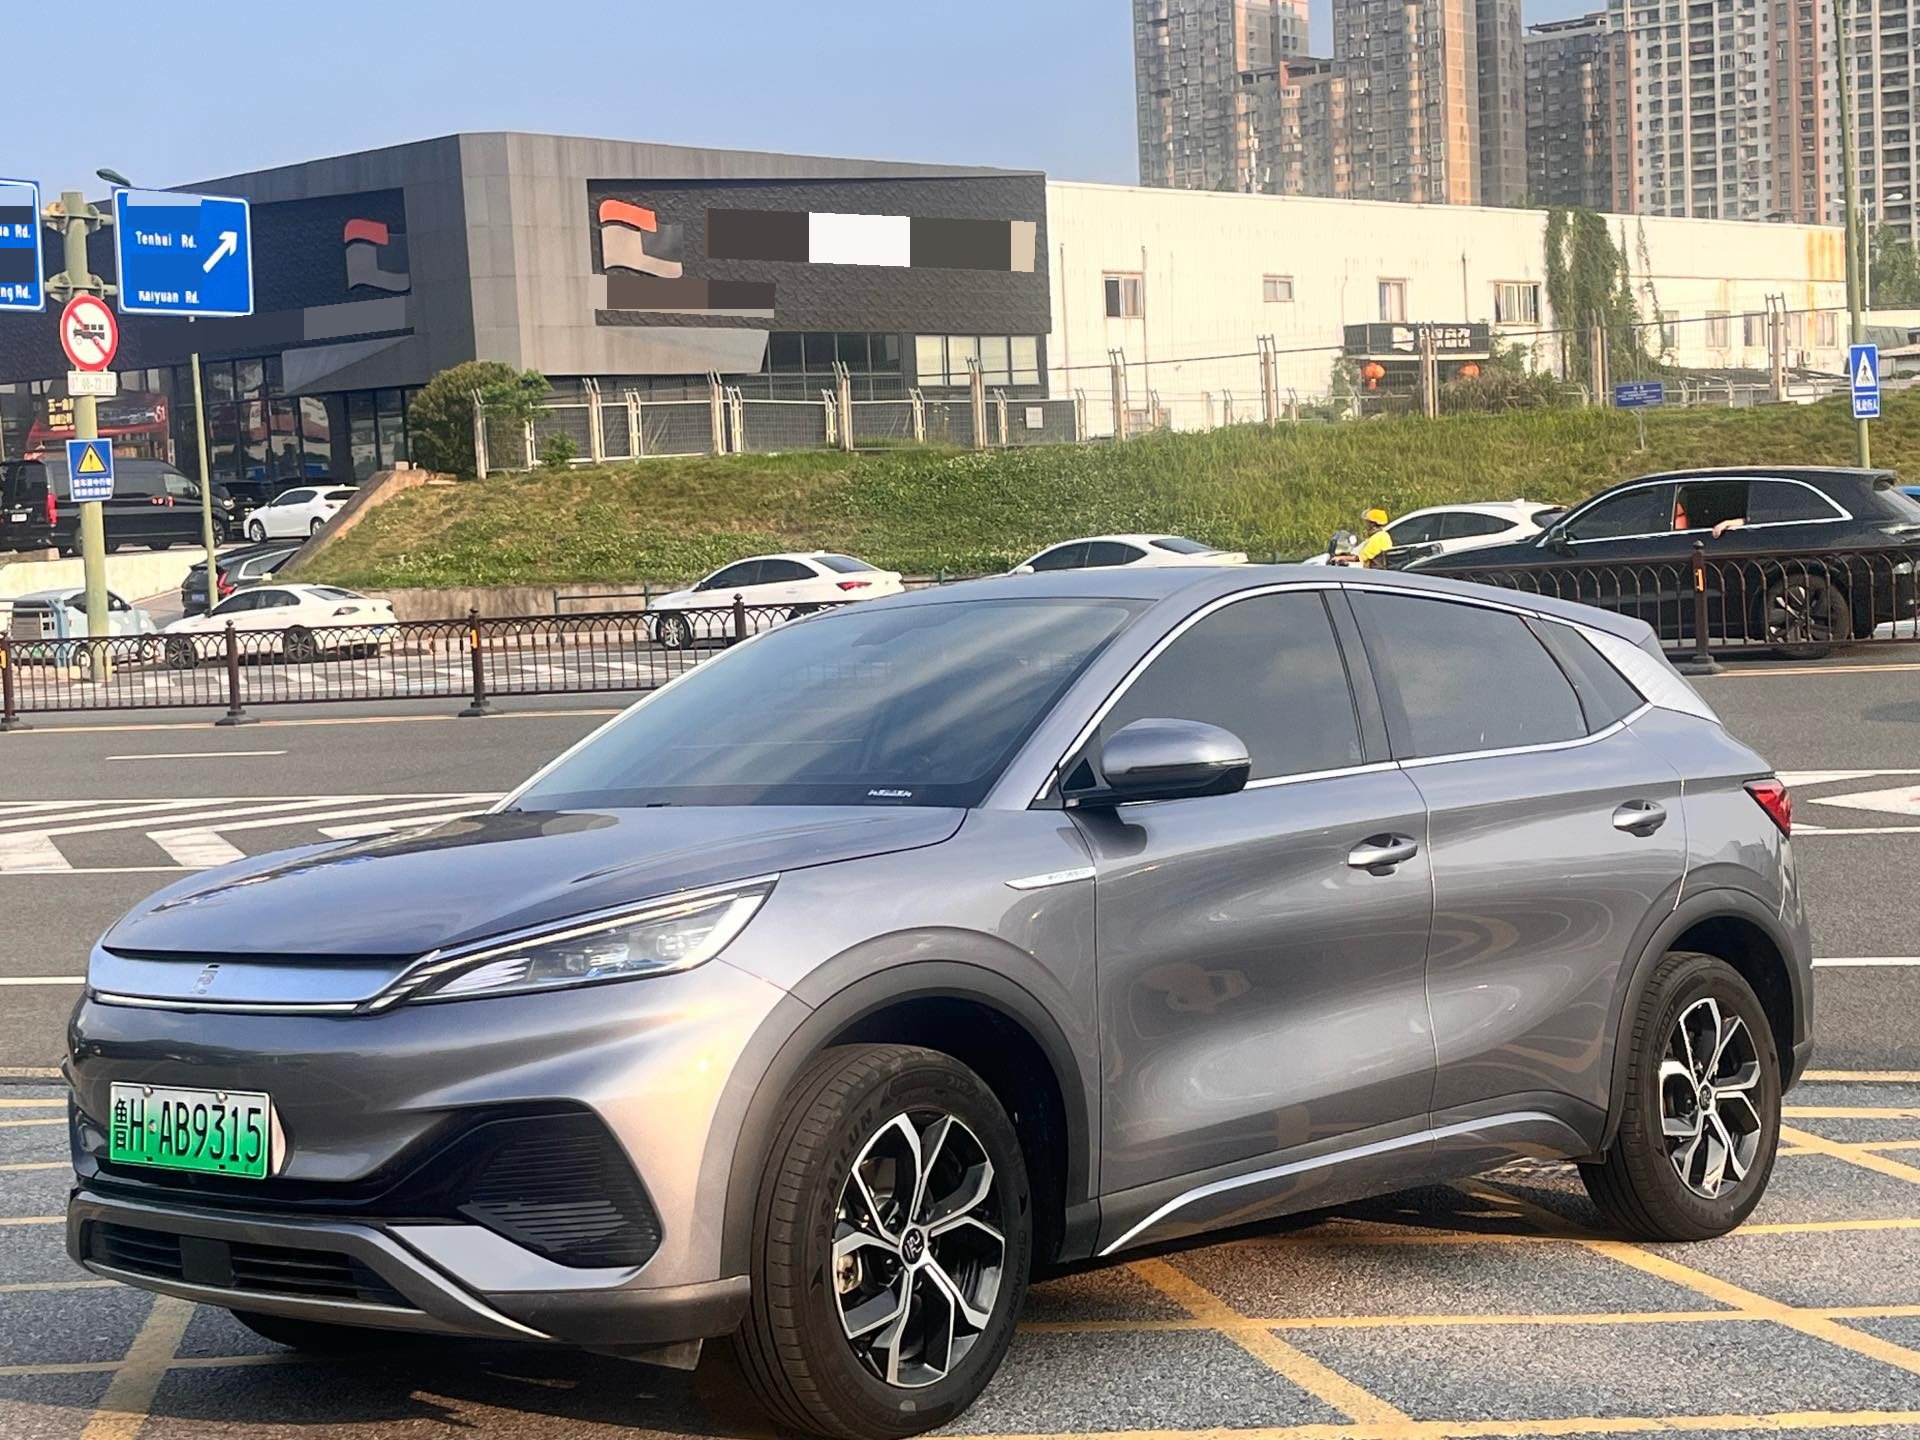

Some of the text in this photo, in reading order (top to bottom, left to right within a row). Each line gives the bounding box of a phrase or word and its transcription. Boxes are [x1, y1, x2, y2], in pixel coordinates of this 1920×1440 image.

[15, 224, 32, 239] Rd.
[181, 233, 197, 249] Rd.
[15, 284, 32, 299] Rd.
[185, 290, 200, 304] Rd.
